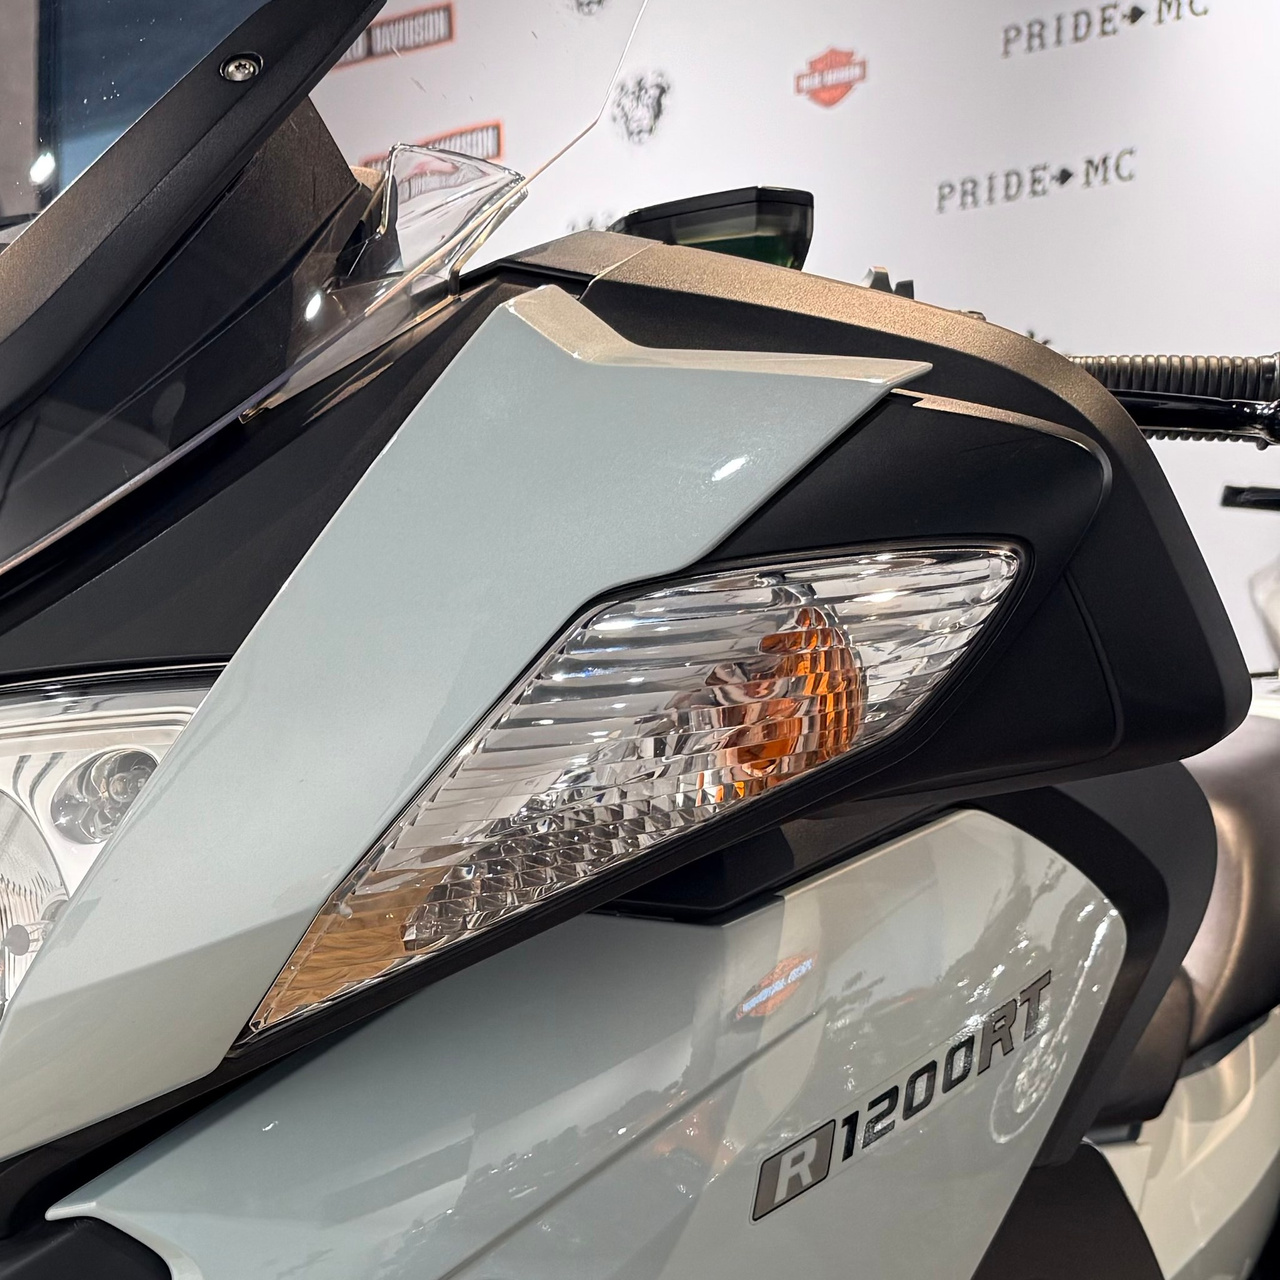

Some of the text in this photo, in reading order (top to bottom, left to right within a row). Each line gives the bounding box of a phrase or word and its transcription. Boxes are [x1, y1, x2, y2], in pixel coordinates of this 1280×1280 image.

[1001, 3, 1120, 59] PRIDE
[936, 147, 1137, 214] PRIDE MC
